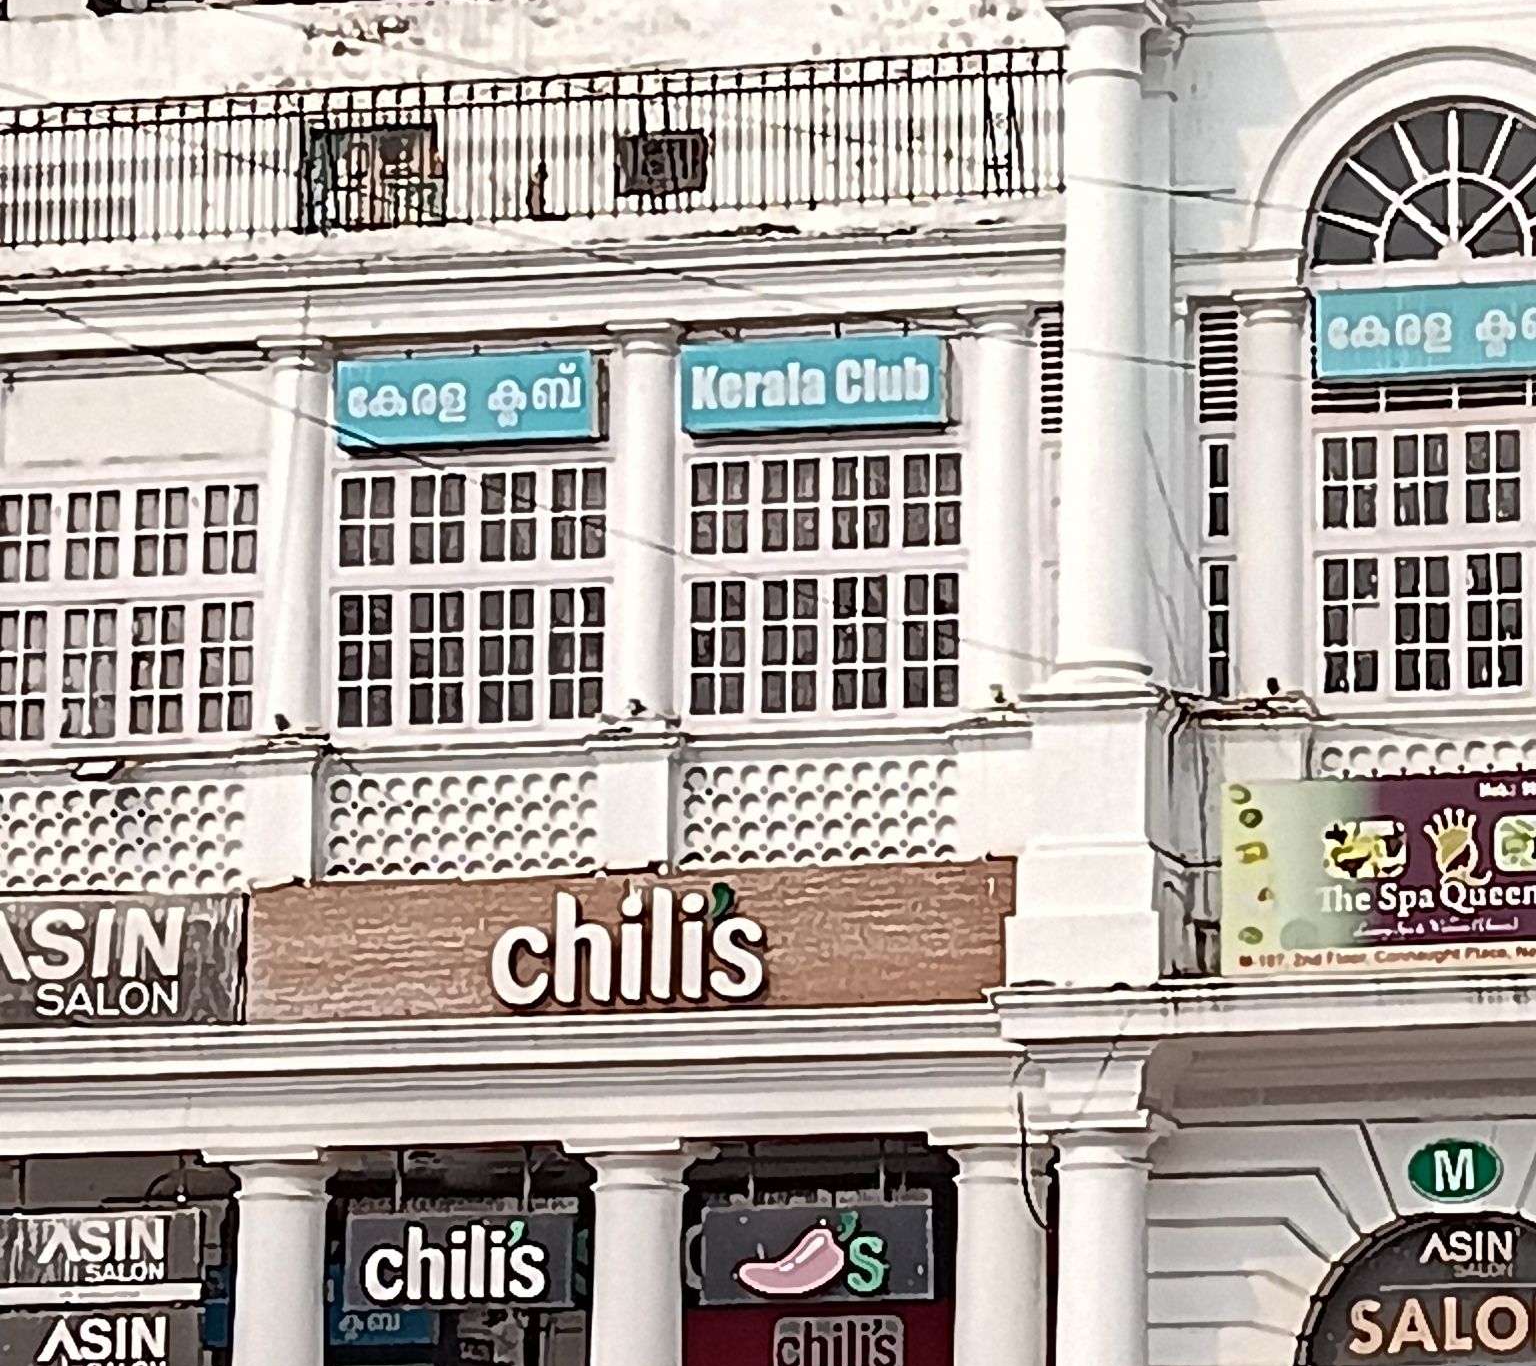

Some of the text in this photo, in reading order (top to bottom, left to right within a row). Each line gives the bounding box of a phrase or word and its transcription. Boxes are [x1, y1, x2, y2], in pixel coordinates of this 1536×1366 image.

[691, 356, 929, 410] Kerala Club
[1316, 883, 1371, 912] The
[1378, 882, 1435, 917] Spa
[491, 882, 764, 1005] chili's
[36, 981, 179, 1016] SALON
[1433, 1148, 1475, 1192] M
[38, 1218, 165, 1263] ASIN
[364, 1220, 546, 1301] chili's
[1419, 1230, 1513, 1263] ASIN
[85, 1262, 165, 1282] SALON
[37, 1316, 167, 1362] ASIN
